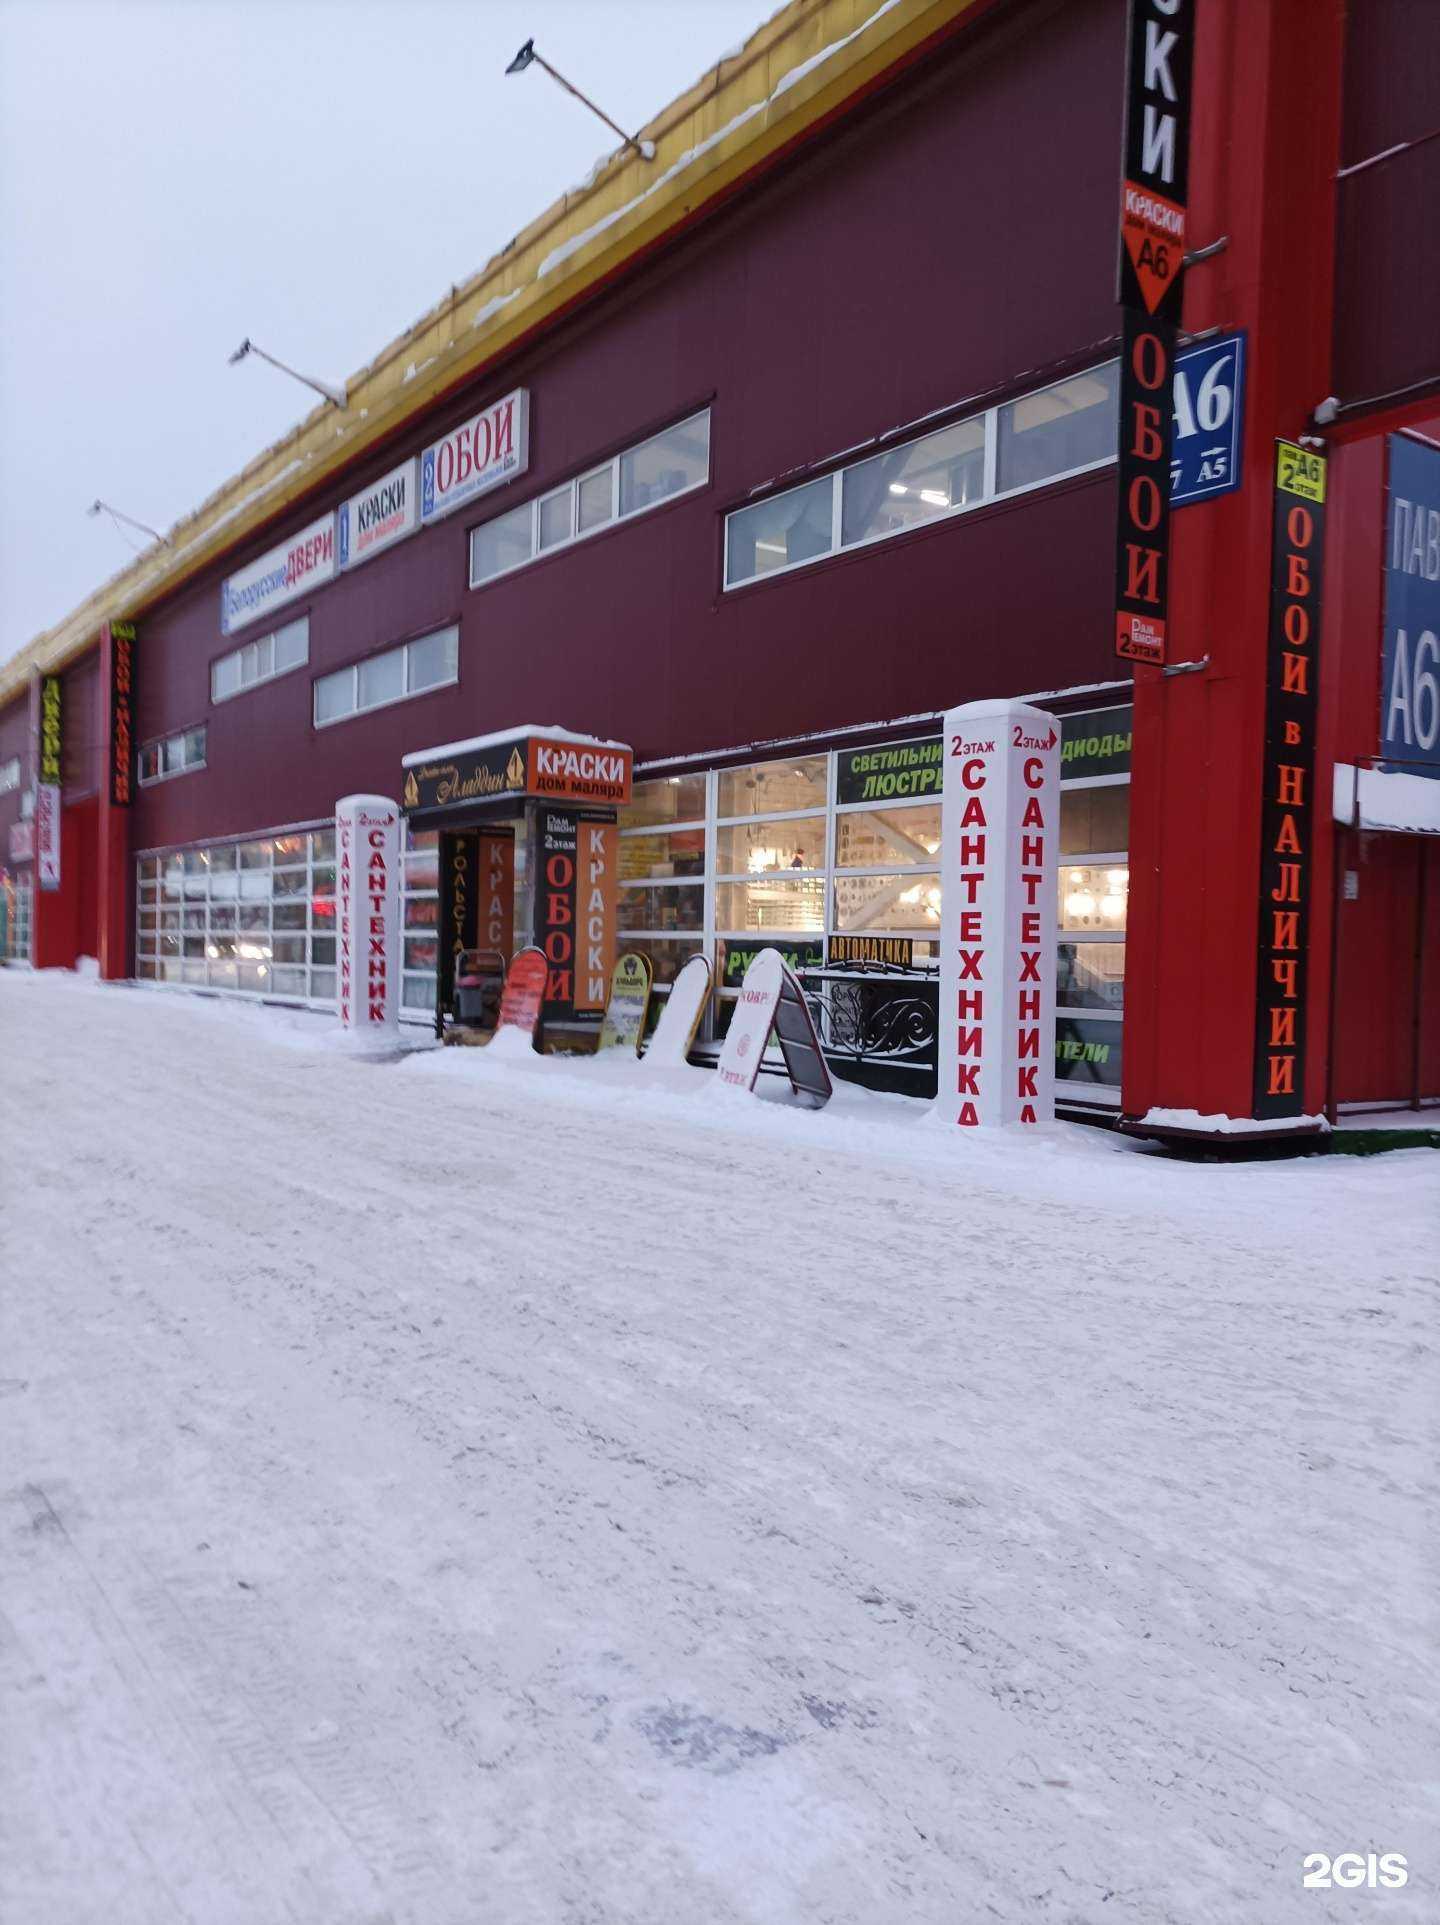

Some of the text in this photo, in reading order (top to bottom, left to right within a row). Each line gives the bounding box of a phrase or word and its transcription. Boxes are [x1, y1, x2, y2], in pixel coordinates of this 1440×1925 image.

[1141, 0, 1180, 184] КИ
[1126, 188, 1184, 236] КРАСКИ
[1137, 239, 1169, 280] А6
[437, 399, 514, 494] ОБОИ
[1173, 354, 1234, 440] А6
[358, 477, 405, 533] КРАСКИ
[1122, 333, 1166, 604] ОБОИ
[1196, 456, 1228, 483] А5
[286, 526, 333, 586] ДВЕРИ
[1281, 507, 1313, 695] ОБОИ
[1386, 628, 1440, 751] А6
[536, 777, 624, 799] дом маляра
[537, 746, 624, 783] КРАСКИ
[340, 830, 351, 1030] САНТЕХНИК
[367, 829, 387, 1028] САНТЕХНИК
[488, 843, 503, 951] КРАС
[544, 854, 574, 1001] ОБОИ
[588, 829, 605, 1001] КРАСКИ
[957, 759, 987, 1126] САНТЕХНИКА
[1018, 757, 1044, 1123] САНТЕХНИКА
[1267, 764, 1305, 1096] НАЛИЧИИ
